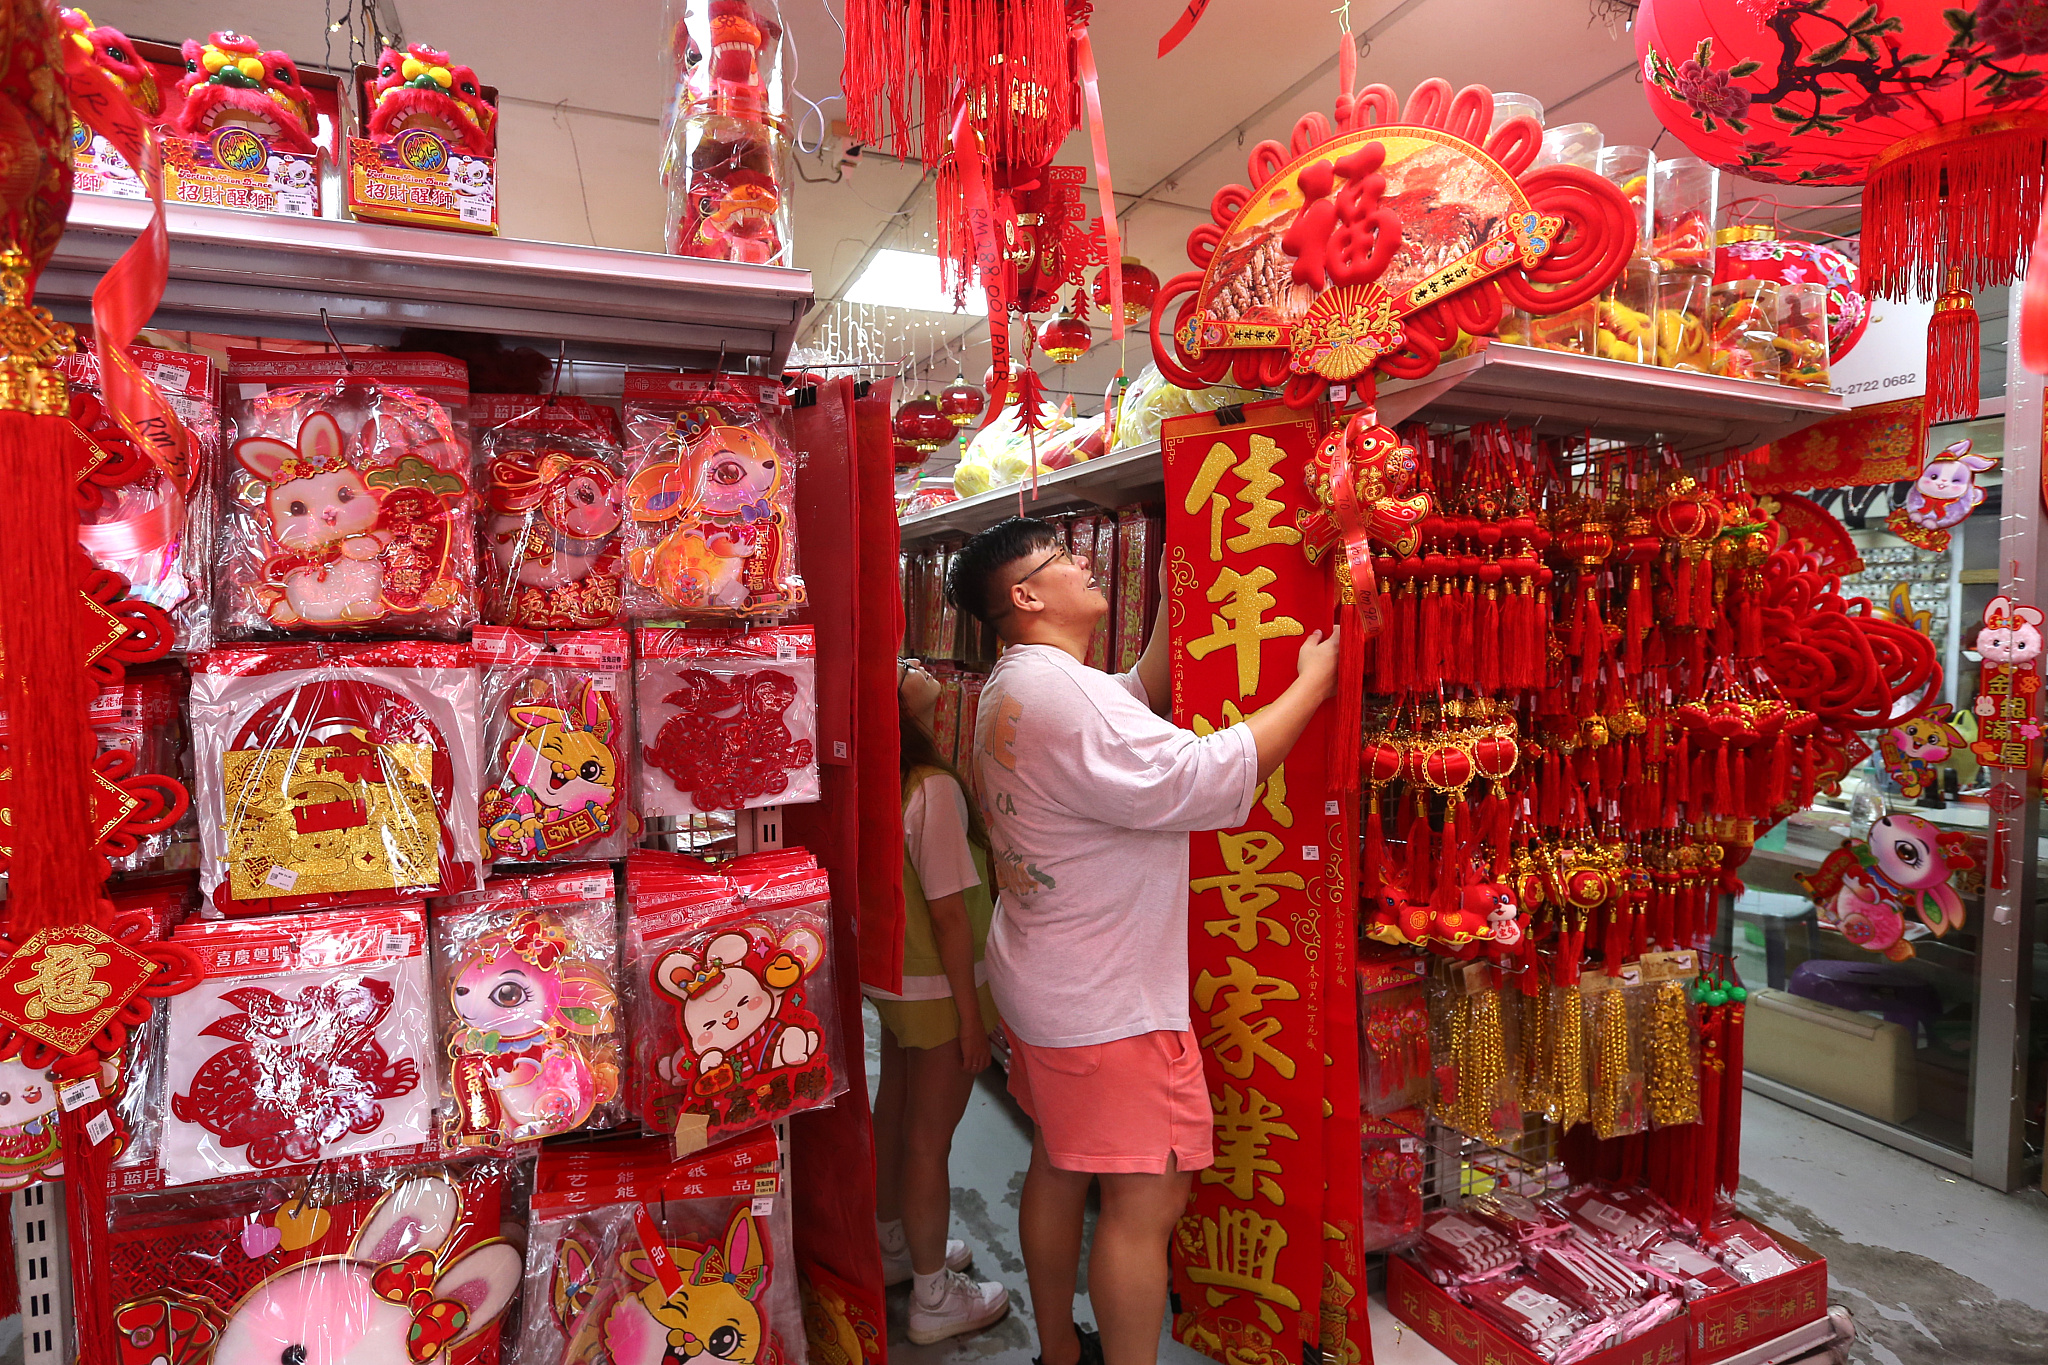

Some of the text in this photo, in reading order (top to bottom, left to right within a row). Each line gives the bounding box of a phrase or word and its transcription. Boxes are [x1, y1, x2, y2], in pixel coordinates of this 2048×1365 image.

[178, 169, 272, 188] Fortune Lion Dance
[366, 169, 452, 187] Fortune Lion Dance
[178, 183, 273, 211] 招財醒獅
[365, 181, 453, 209] 招財醒獅
[1281, 142, 1401, 292] 福
[1415, 267, 1467, 301] 吉祥如意
[1234, 330, 1276, 341] 年年有余
[1289, 297, 1401, 352] 鸿运当头
[1883, 372, 1916, 388] 0682
[548, 814, 591, 841] 迎春
[1710, 1314, 1749, 1346] 花季
